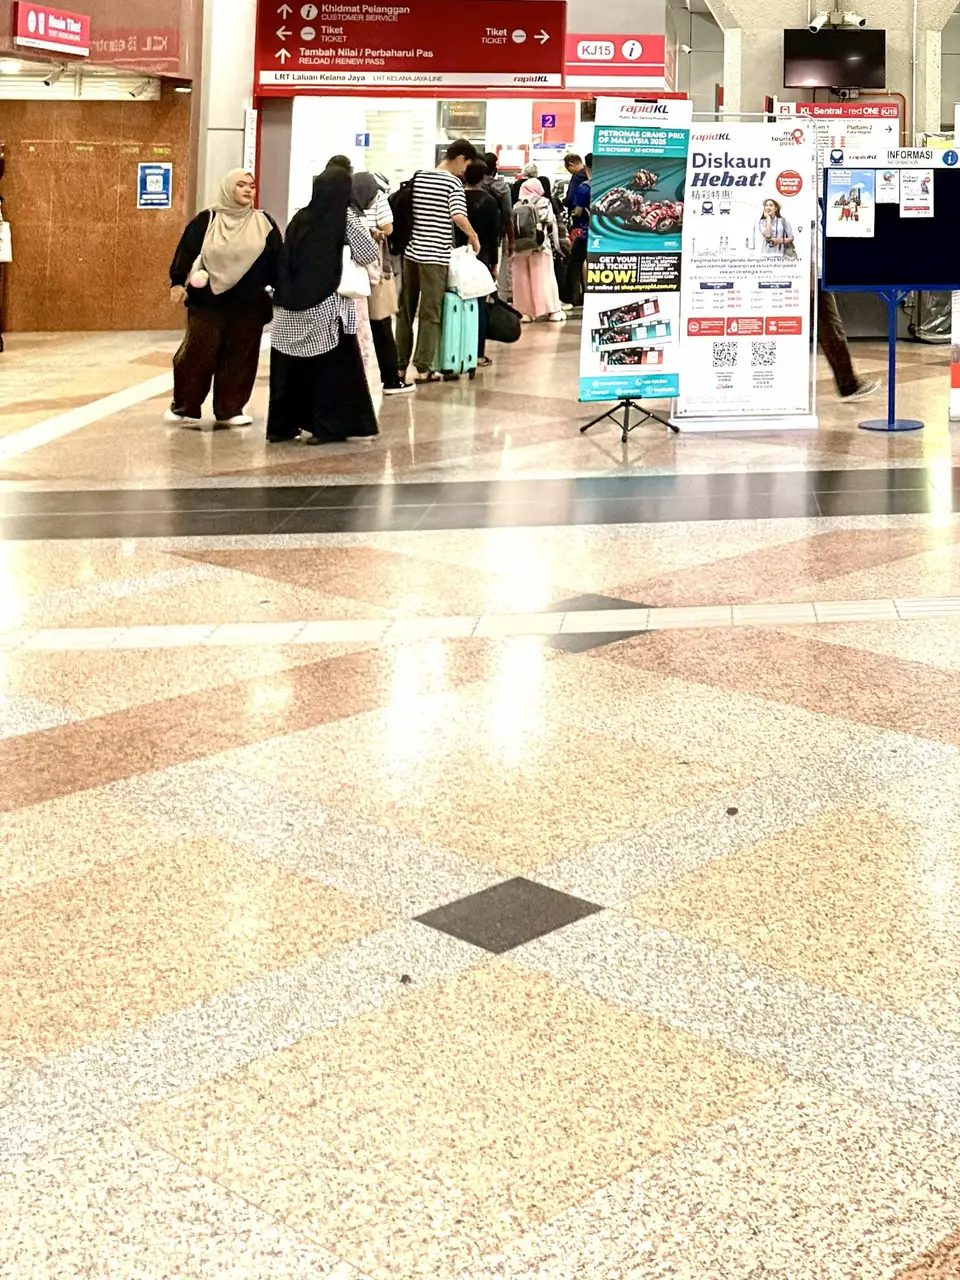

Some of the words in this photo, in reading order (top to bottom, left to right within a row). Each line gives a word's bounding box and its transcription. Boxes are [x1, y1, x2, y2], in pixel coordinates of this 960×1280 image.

[321, 4, 360, 13] Khidmat
[362, 4, 411, 15] Pelanggan
[320, 25, 344, 34] Tiket
[485, 27, 508, 36] Tiket
[320, 35, 348, 43] TICKET
[481, 37, 507, 45] TICKET
[299, 47, 336, 57] Tambah
[337, 48, 358, 57] Nilai
[365, 48, 415, 58] Perbaharui
[416, 49, 434, 58] Pas
[581, 45, 612, 56] KJ15
[298, 57, 331, 65] RELOAD
[335, 57, 366, 65] RENEW
[274, 73, 290, 81] LRT
[292, 73, 319, 81] Laluan
[347, 74, 366, 83] Jaya
[513, 74, 549, 83] rapidKL
[620, 104, 669, 114] rapidKL
[800, 106, 812, 114] KL
[813, 106, 843, 115] Sentral
[544, 115, 553, 126] 2
[598, 130, 640, 138] PETRONAS
[641, 131, 667, 139] GRAND
[691, 132, 731, 142] rapidKL
[611, 137, 650, 145] MALAYSIA
[887, 150, 933, 159] INFORMASI
[692, 151, 771, 169] Diskaun
[690, 170, 767, 187] Hebat!
[605, 262, 637, 270] TICKETS
[587, 270, 637, 283] NOW!
